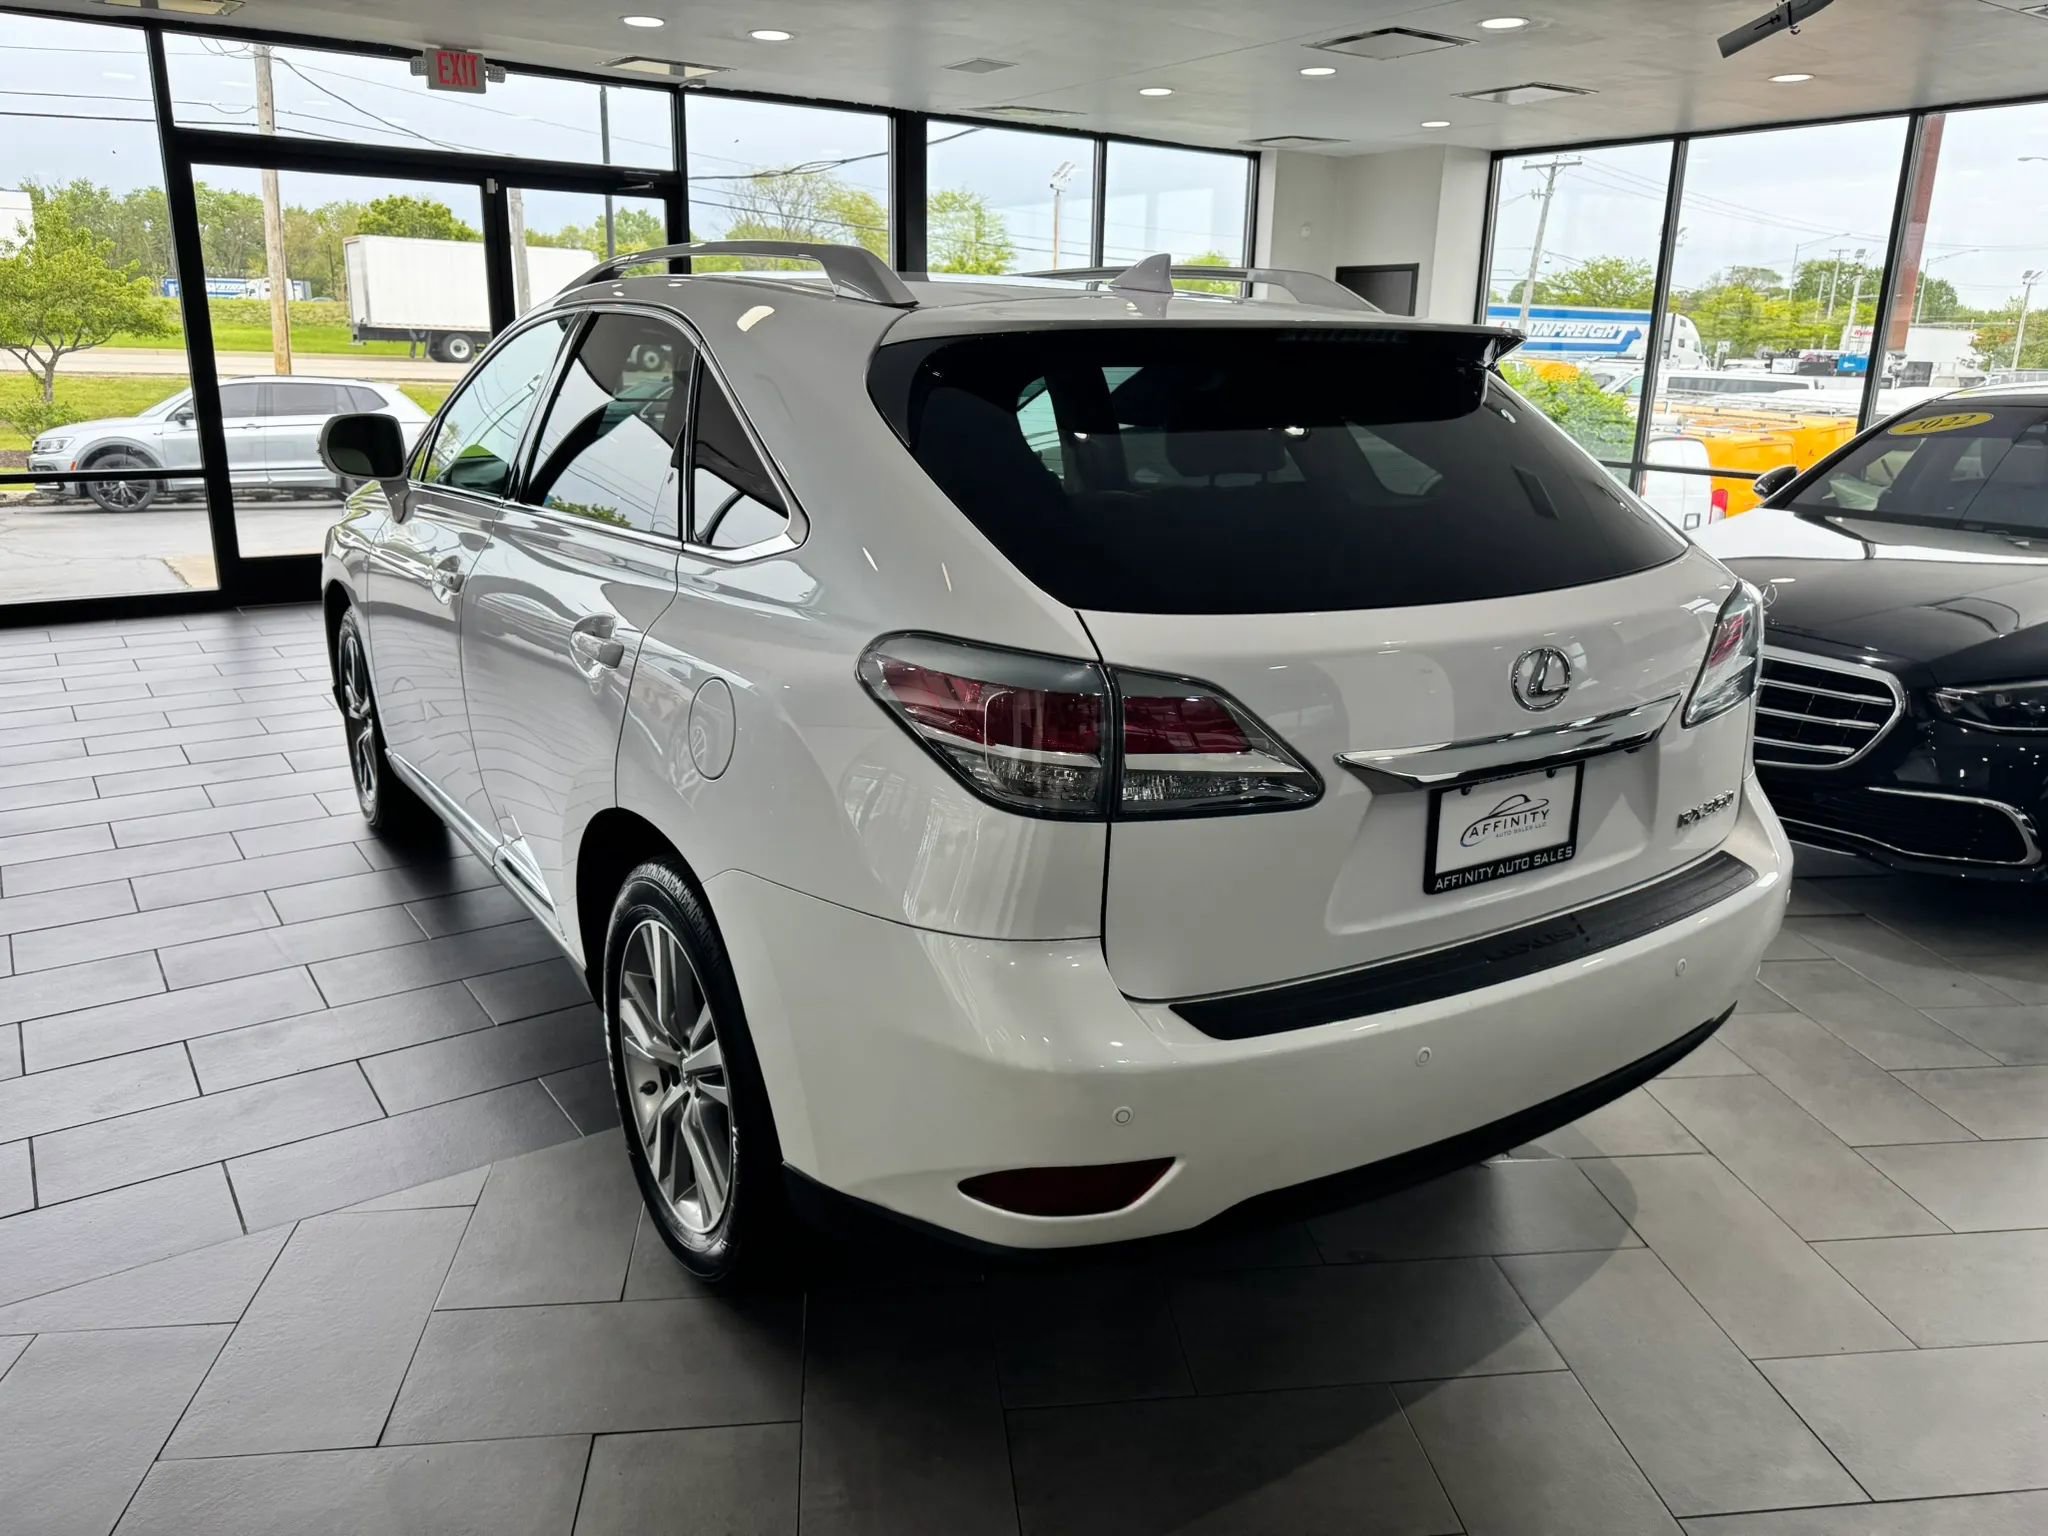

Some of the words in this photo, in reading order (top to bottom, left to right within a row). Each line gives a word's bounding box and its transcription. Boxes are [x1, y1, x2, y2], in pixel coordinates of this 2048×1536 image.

[435, 51, 479, 88] EXIT
[1903, 414, 1977, 433] 2022
[1468, 809, 1550, 838] AFFINITY
[1495, 830, 1512, 838] AUTO
[1514, 825, 1533, 834] SALES
[1434, 865, 1494, 891] AFFINITY
[1497, 857, 1530, 875] AUTO
[1533, 846, 1573, 865] SALES
